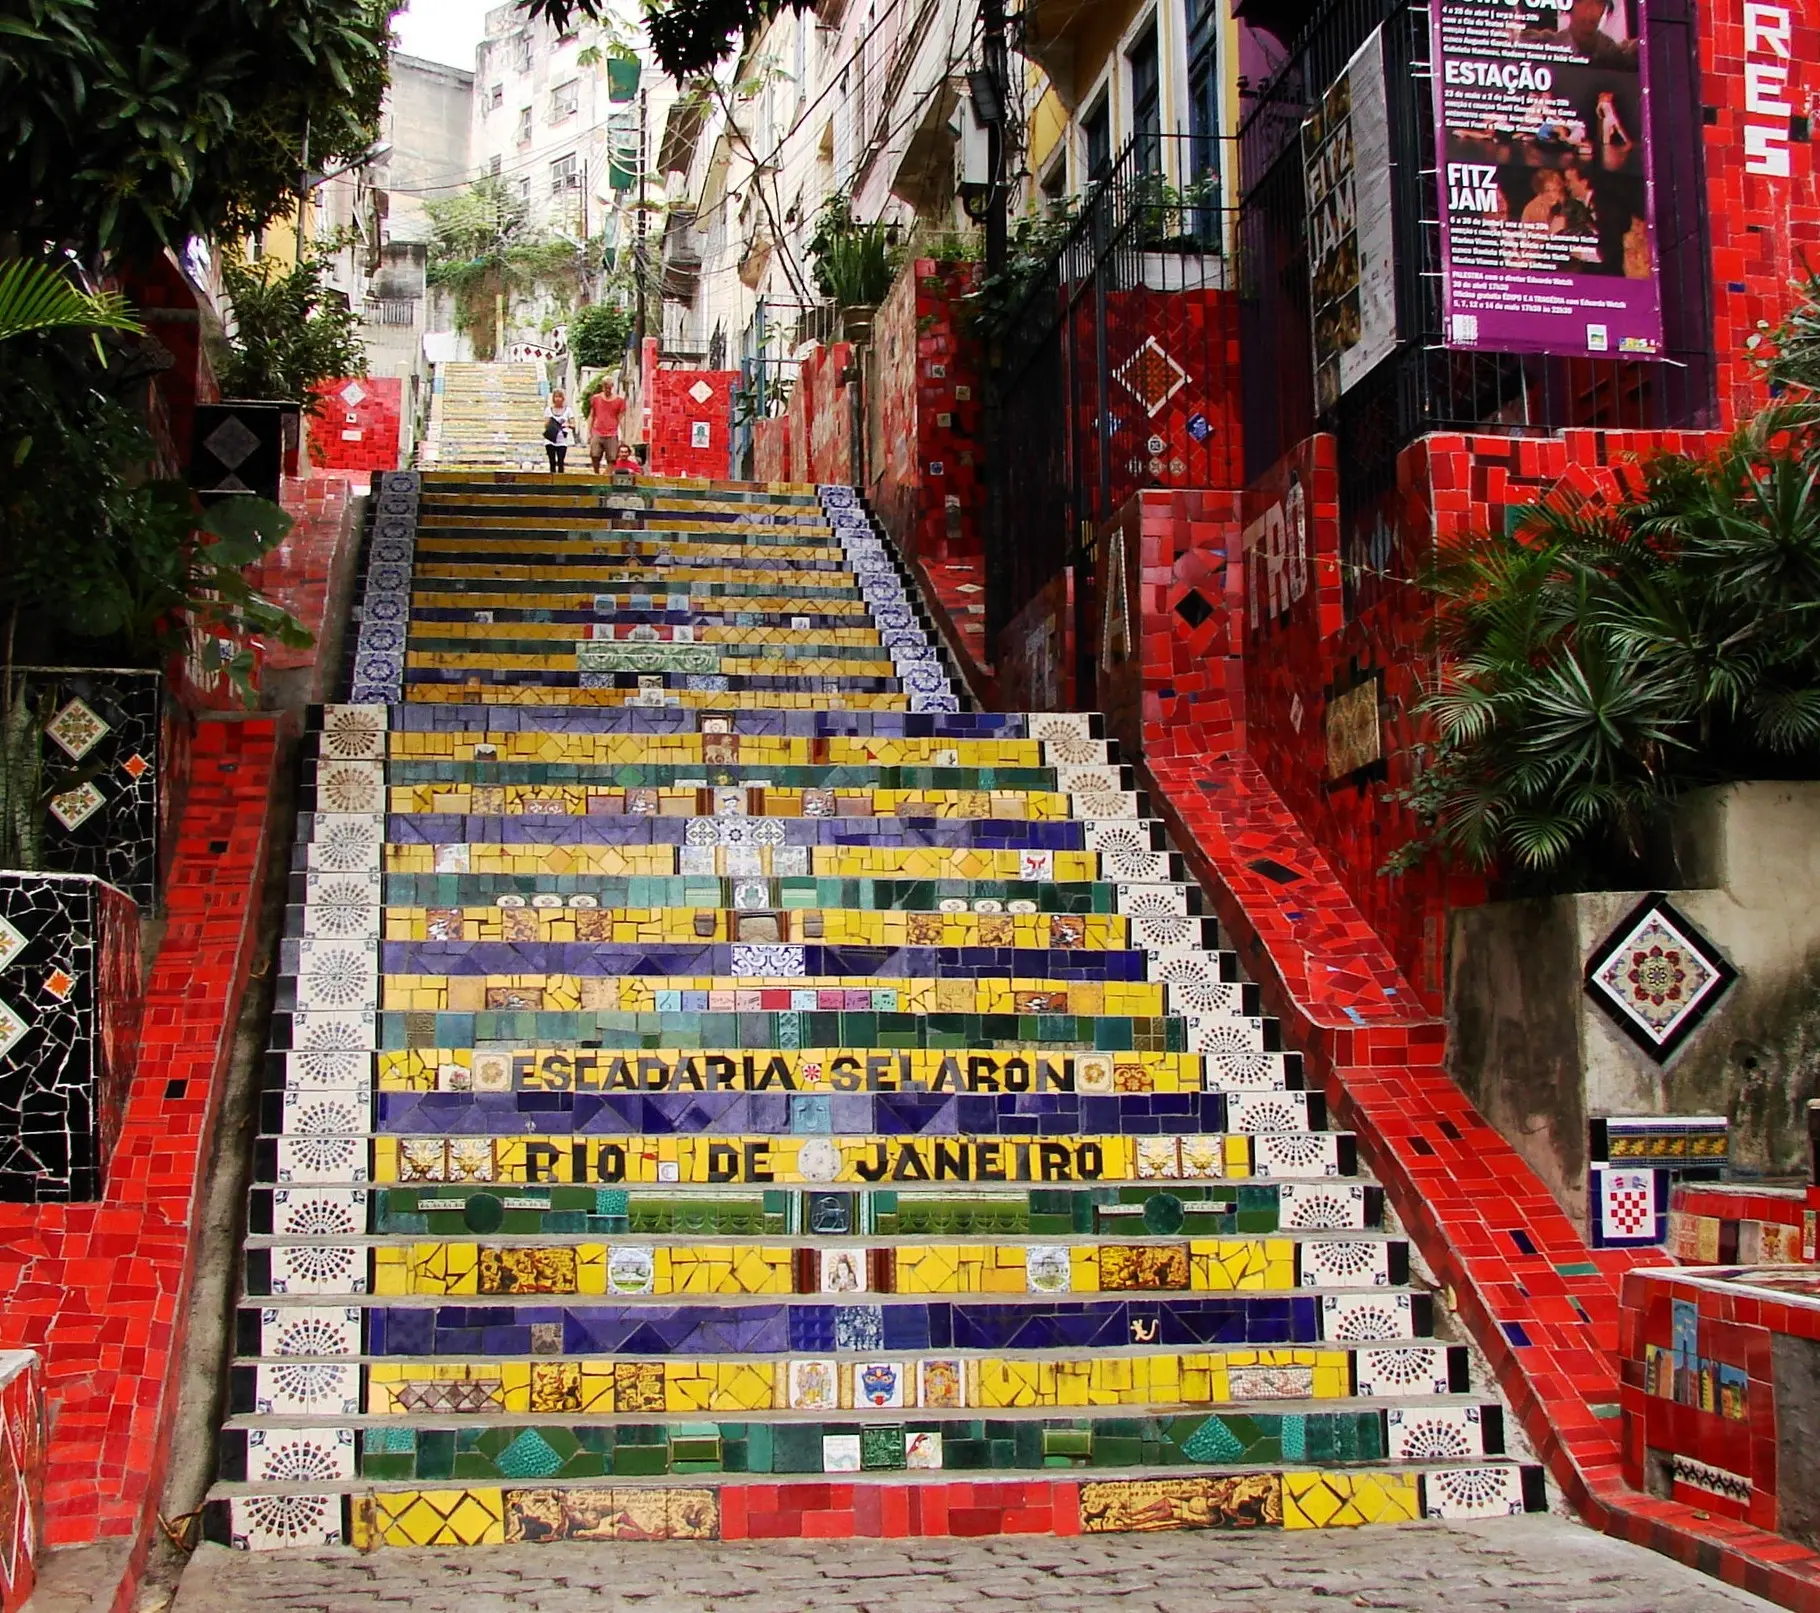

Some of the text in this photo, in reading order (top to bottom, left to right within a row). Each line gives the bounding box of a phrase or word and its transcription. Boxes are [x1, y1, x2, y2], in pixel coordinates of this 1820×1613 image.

[1445, 61, 1552, 94] ESTAÇÃO
[1447, 163, 1498, 189] FITZ
[1448, 186, 1498, 213] JAM
[512, 1055, 1075, 1092] ESCADARIA SELARON
[526, 1142, 1102, 1183] RIO DE JANEIRO
